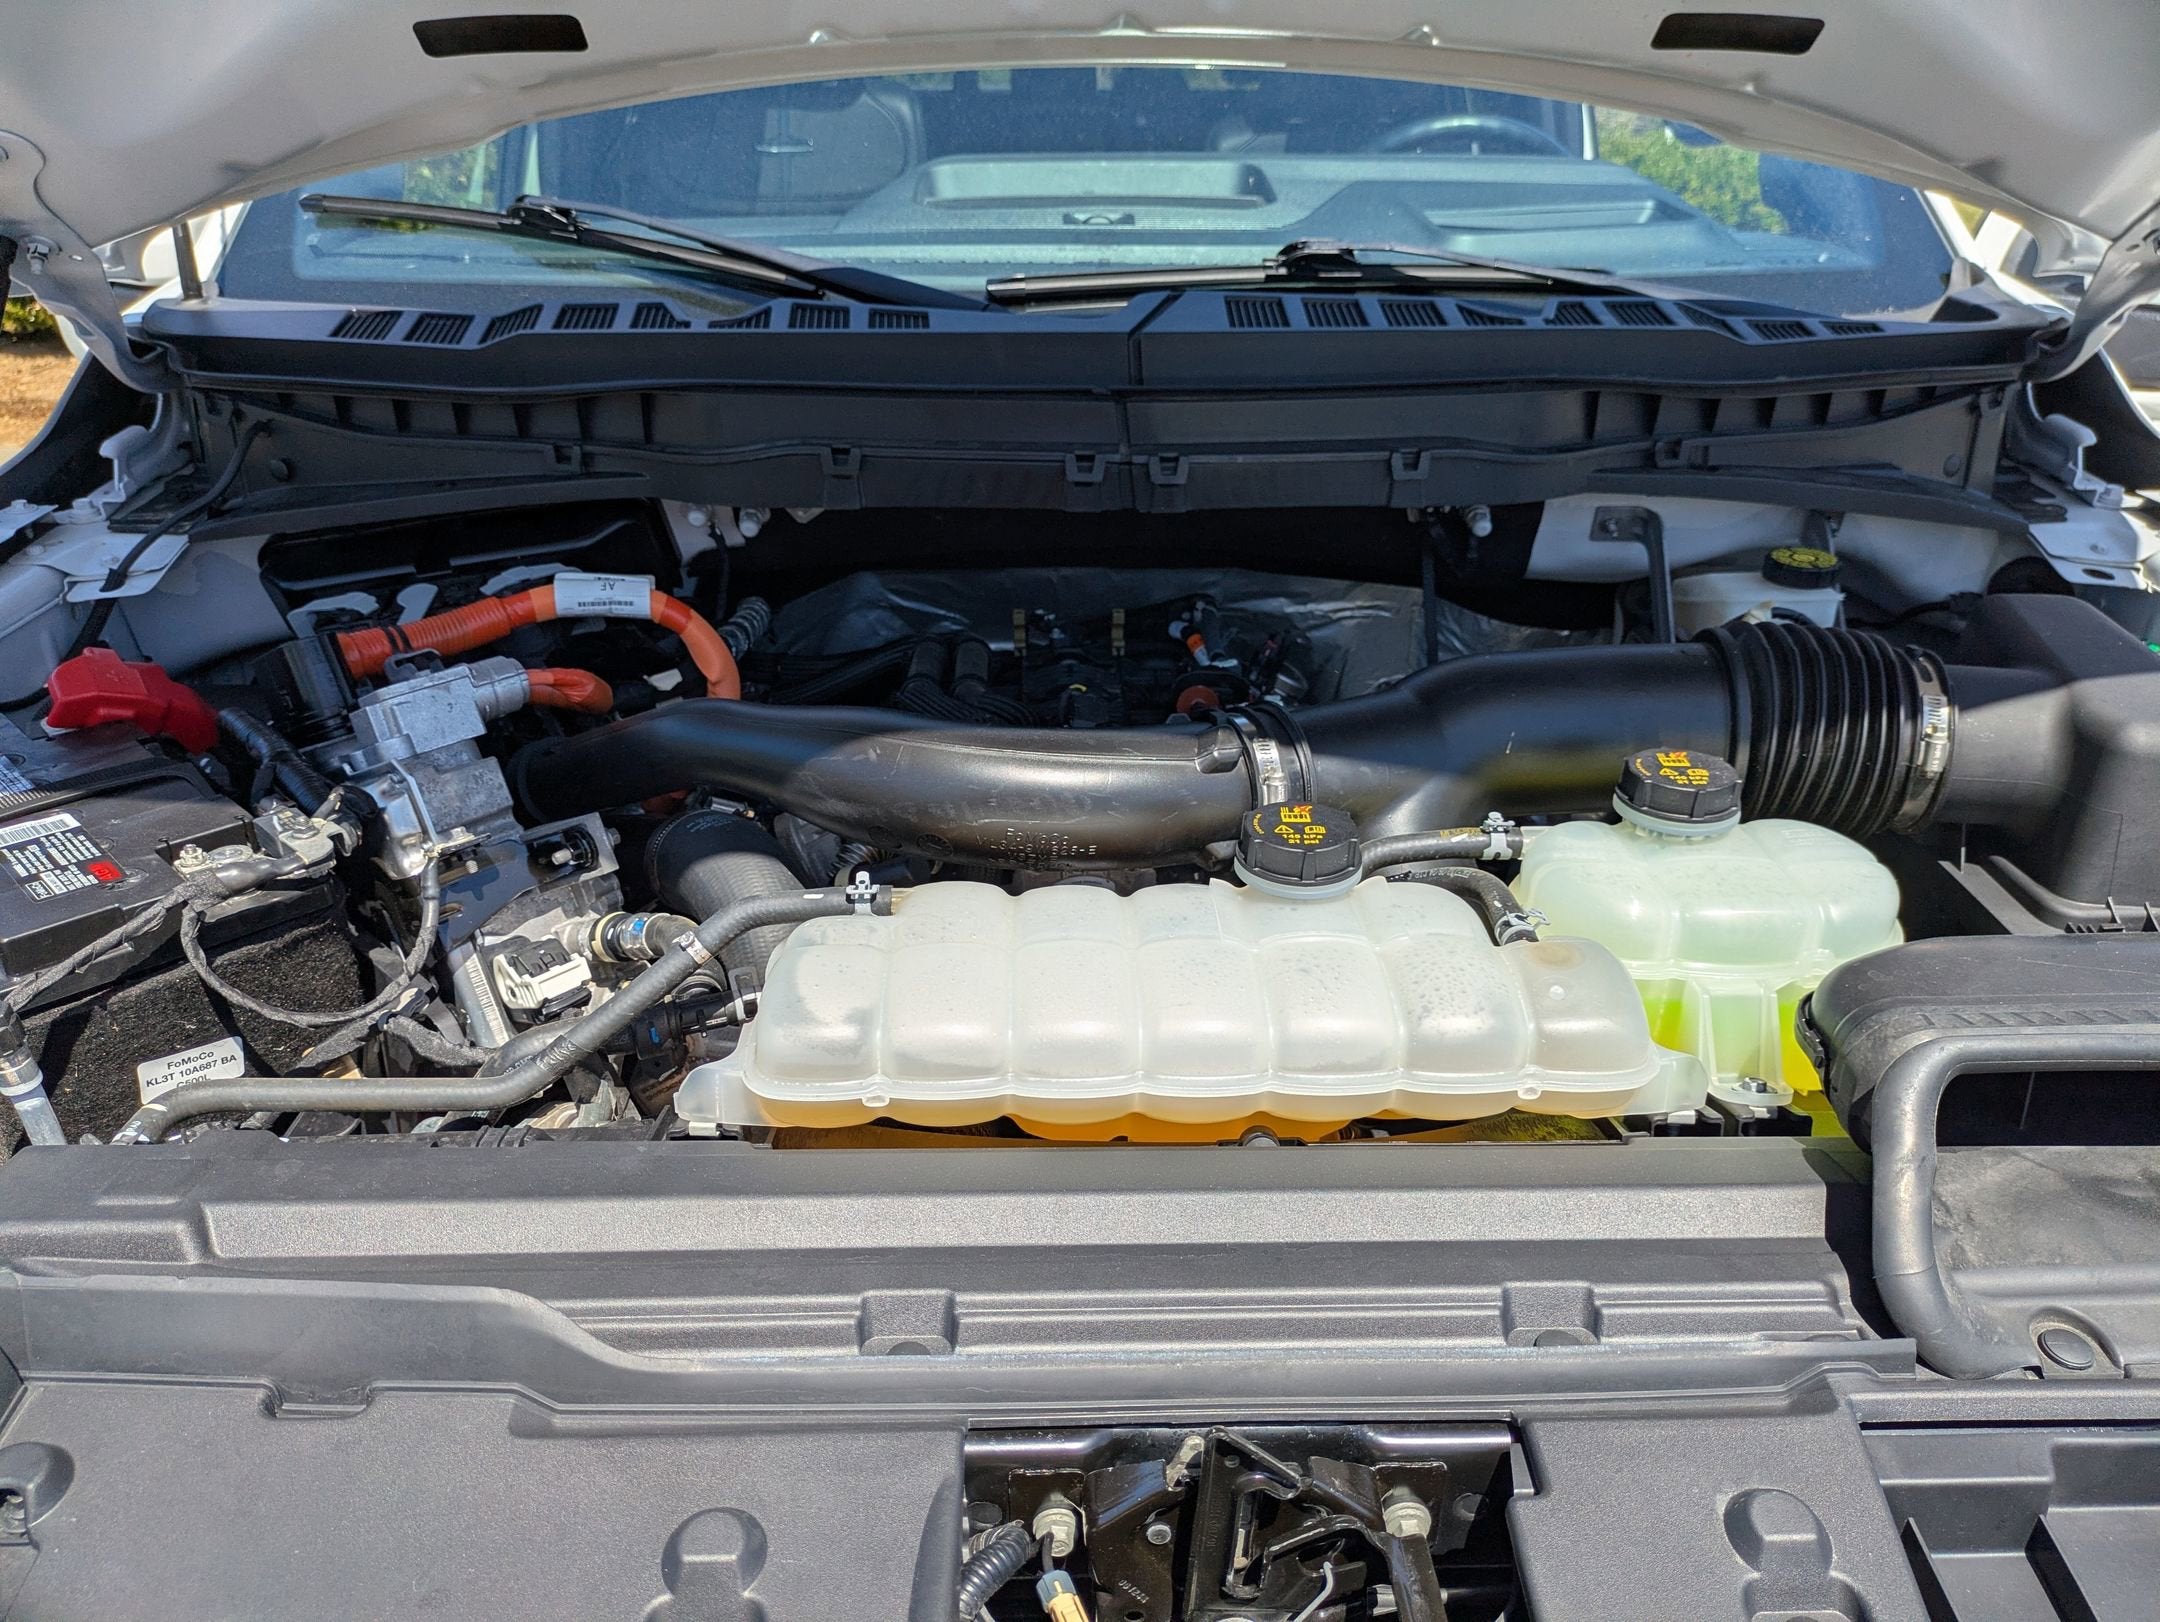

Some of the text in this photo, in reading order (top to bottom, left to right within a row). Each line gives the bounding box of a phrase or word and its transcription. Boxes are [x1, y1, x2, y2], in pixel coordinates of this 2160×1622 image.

[146, 1054, 237, 1087] KL3T 10A687 BA
[167, 1051, 214, 1070] FoMoCo
